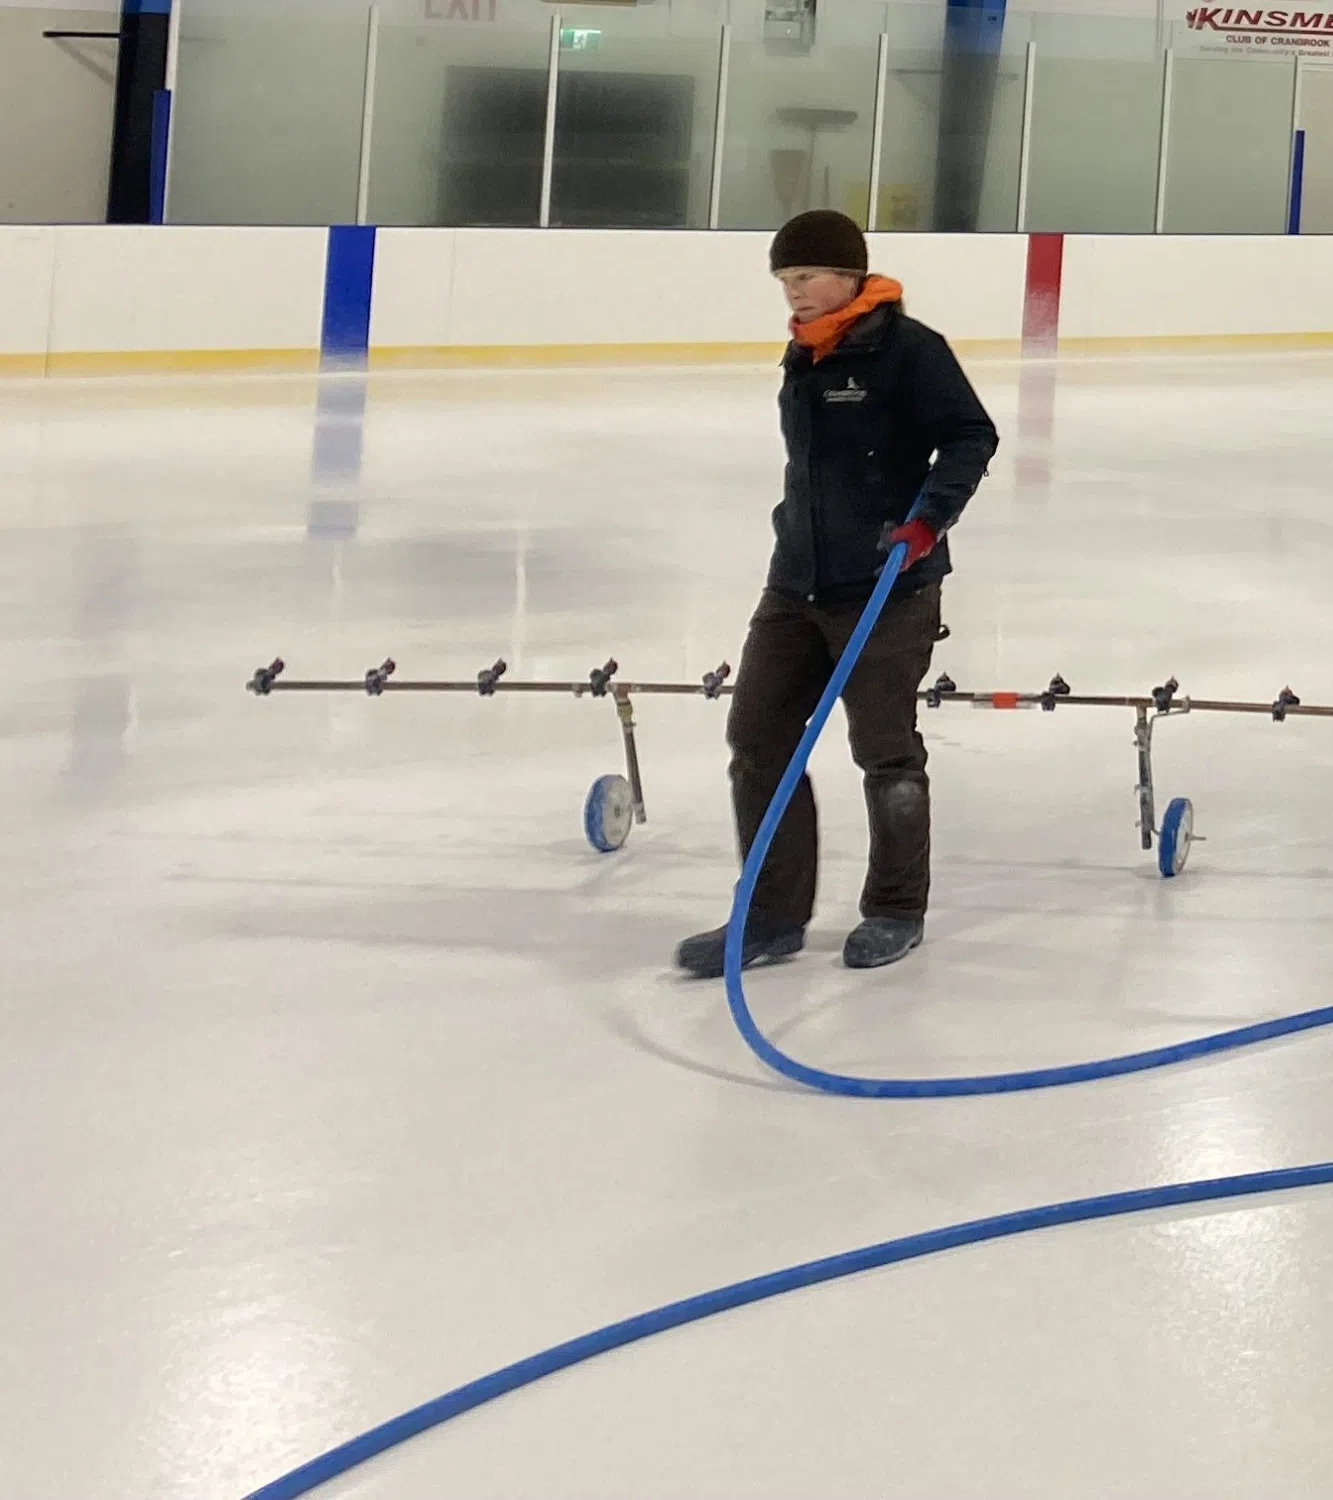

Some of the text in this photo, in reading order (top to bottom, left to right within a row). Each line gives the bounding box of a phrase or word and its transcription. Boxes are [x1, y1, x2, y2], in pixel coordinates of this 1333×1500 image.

[1226, 35, 1330, 47] CLUB OF CRANBROOK
